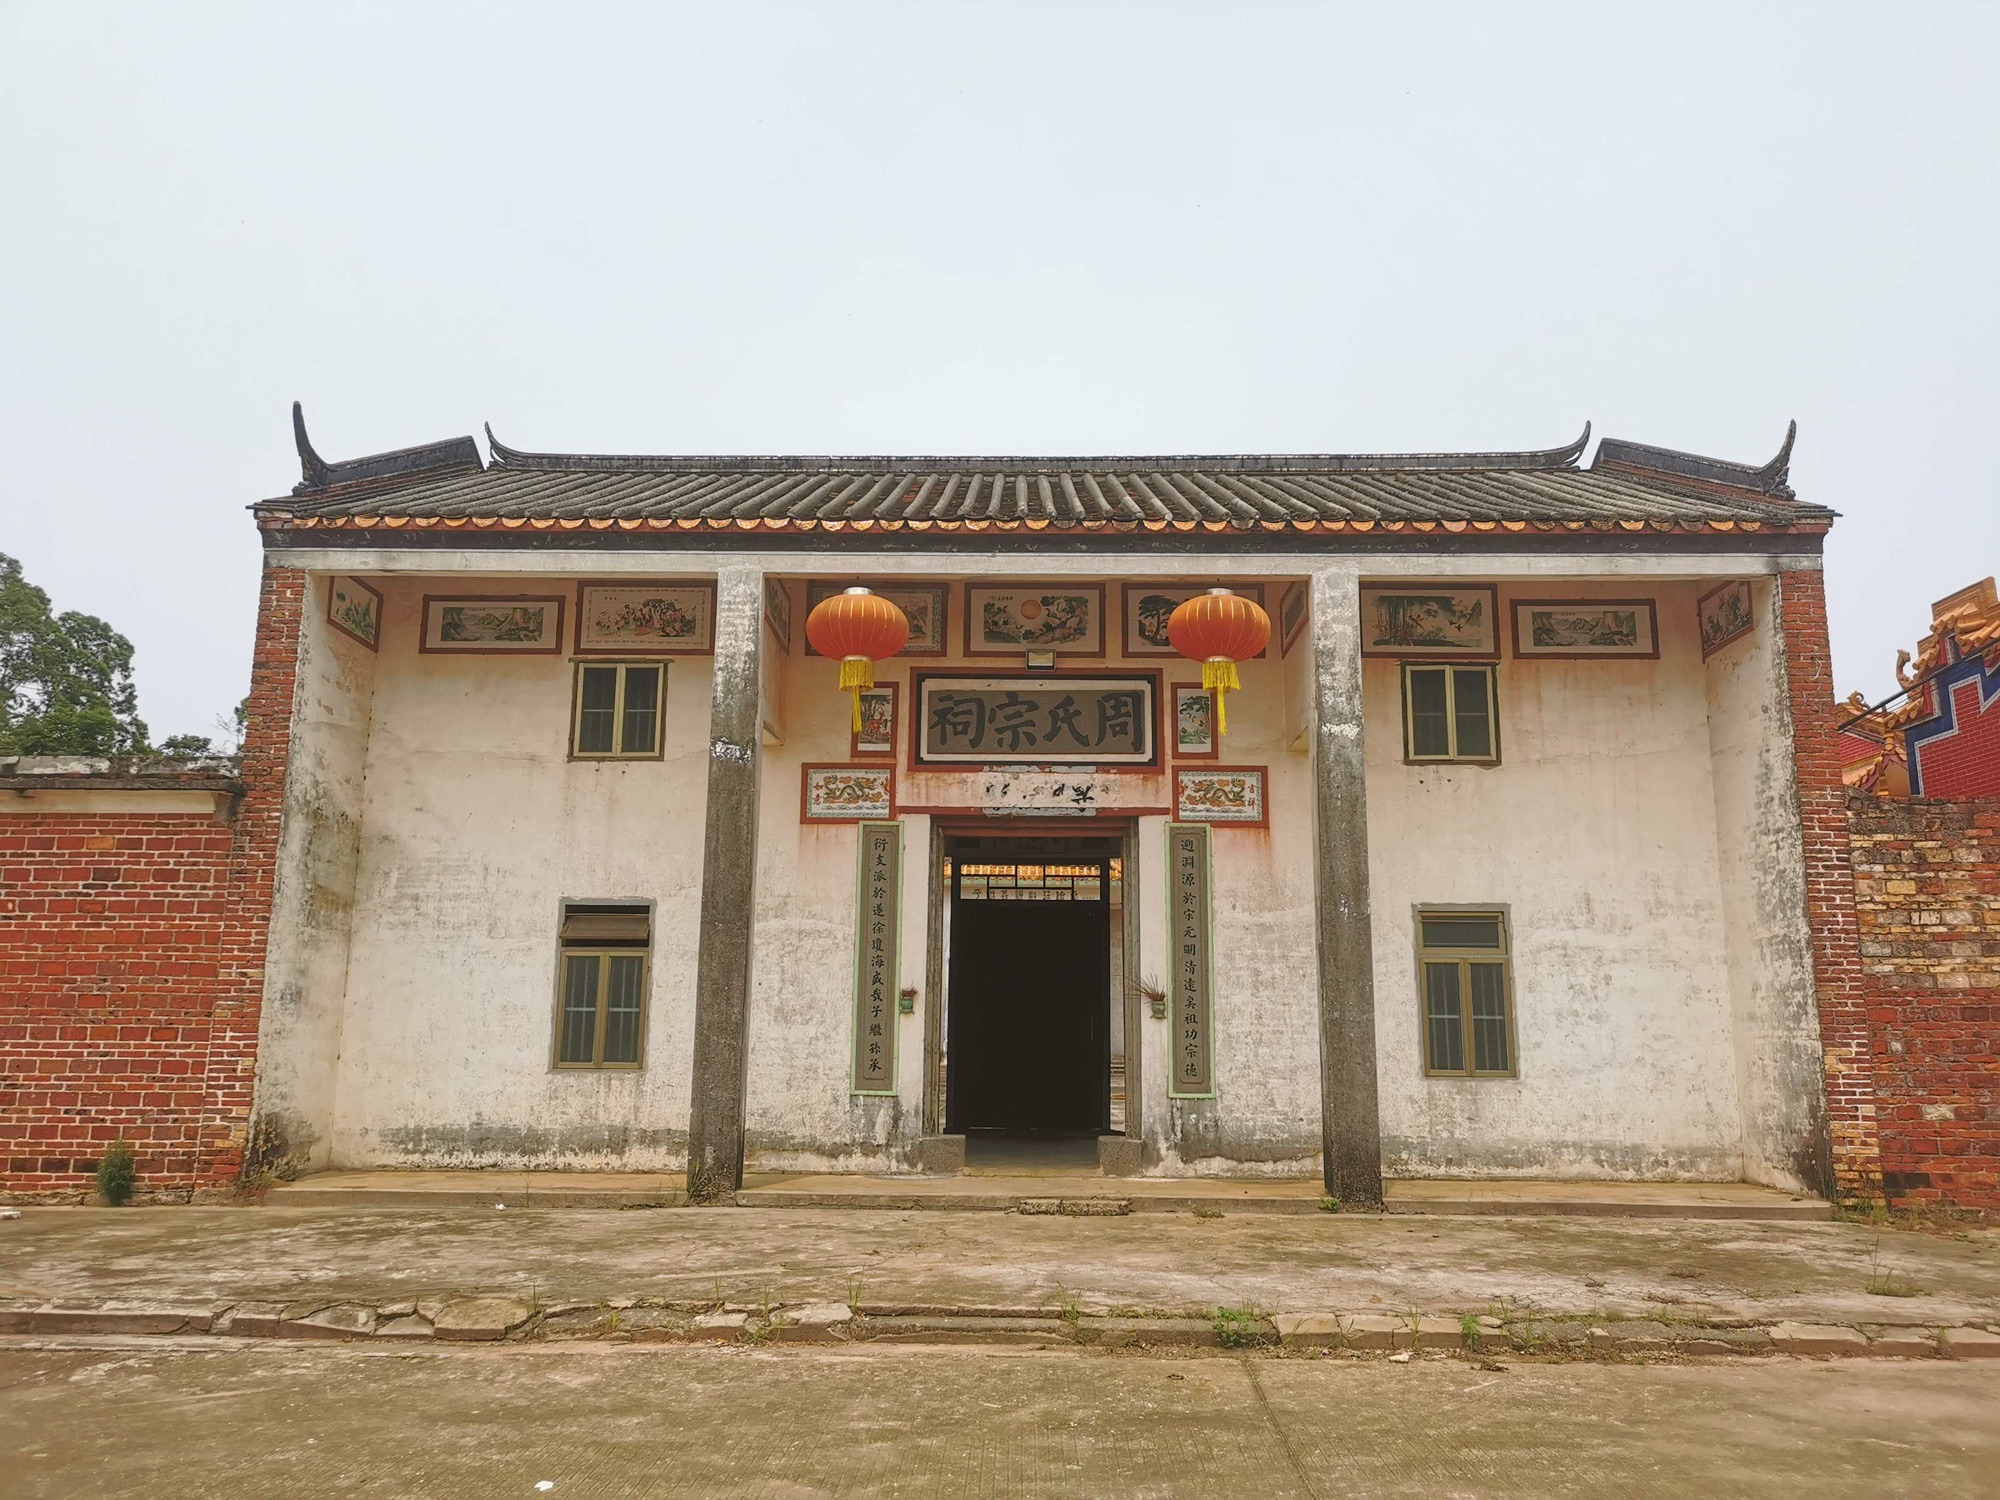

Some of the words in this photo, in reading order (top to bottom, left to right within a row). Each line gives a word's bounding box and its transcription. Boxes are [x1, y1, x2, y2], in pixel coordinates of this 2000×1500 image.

[930, 691, 1143, 752] 周氏宗祠
[1248, 784, 1257, 811] 吉祥
